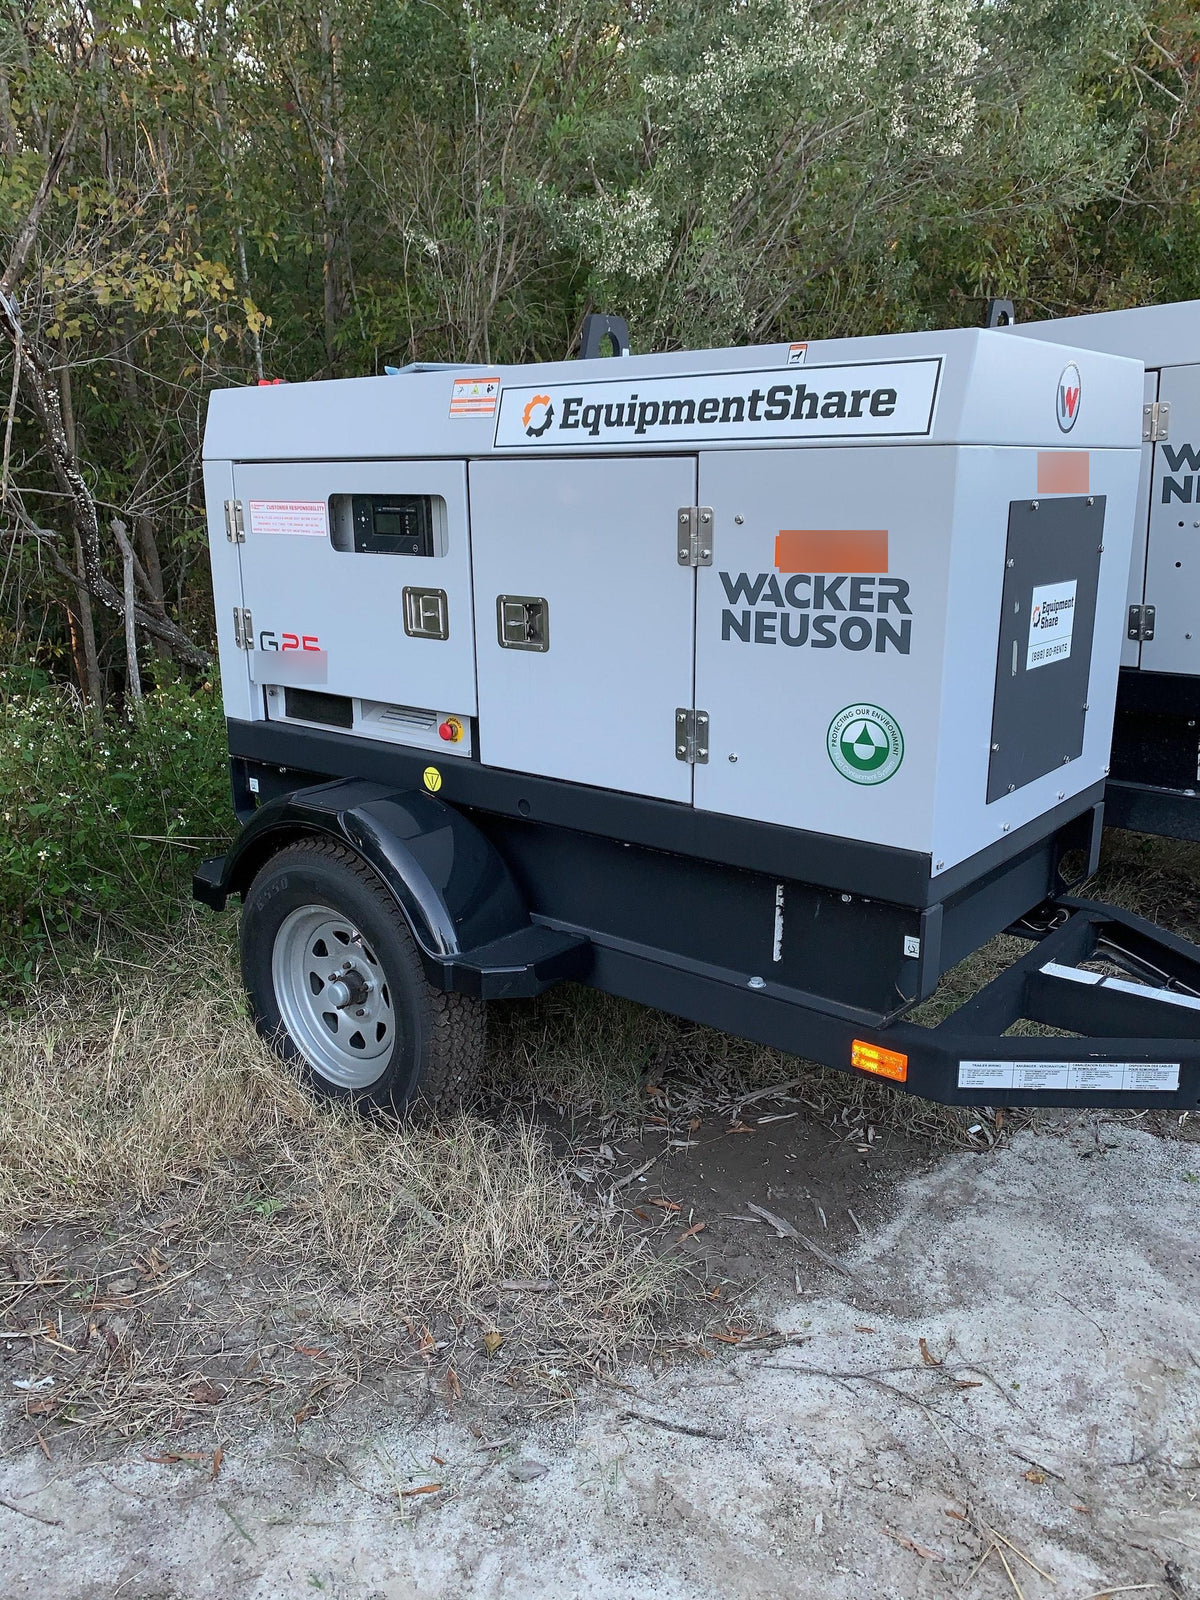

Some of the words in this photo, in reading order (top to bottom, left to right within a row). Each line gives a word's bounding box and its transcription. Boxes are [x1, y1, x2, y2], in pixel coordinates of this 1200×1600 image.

[559, 384, 898, 436] EquipmentShare
[718, 571, 913, 615] WACKER
[1041, 597, 1074, 616] Equipment
[260, 631, 321, 651] G25
[721, 608, 912, 655] NEUSON
[1040, 616, 1059, 629] Share
[831, 710, 854, 748] PROTECTING
[855, 708, 870, 716] OUR
[871, 710, 899, 756] ENVIRONMENT
